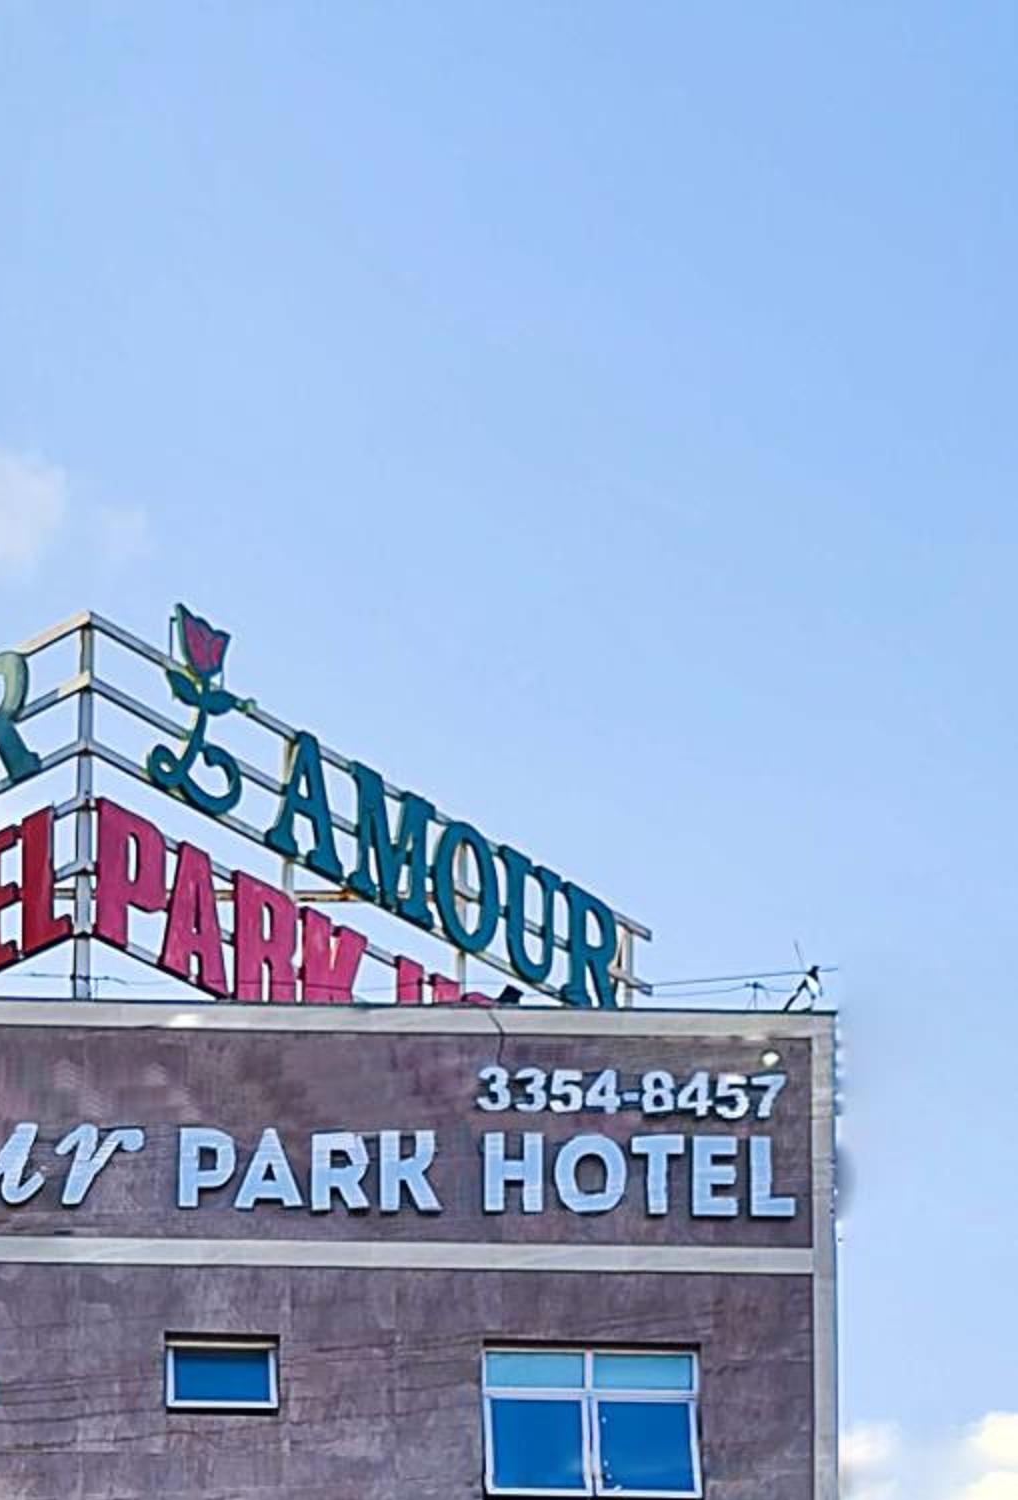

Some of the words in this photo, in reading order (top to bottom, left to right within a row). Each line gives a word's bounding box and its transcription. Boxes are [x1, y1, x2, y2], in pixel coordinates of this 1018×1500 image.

[93, 797, 368, 1004] PARK
[477, 1066, 787, 1120] 3354-8457
[178, 1127, 441, 1214] PARK
[483, 1132, 796, 1220] HOTEL
